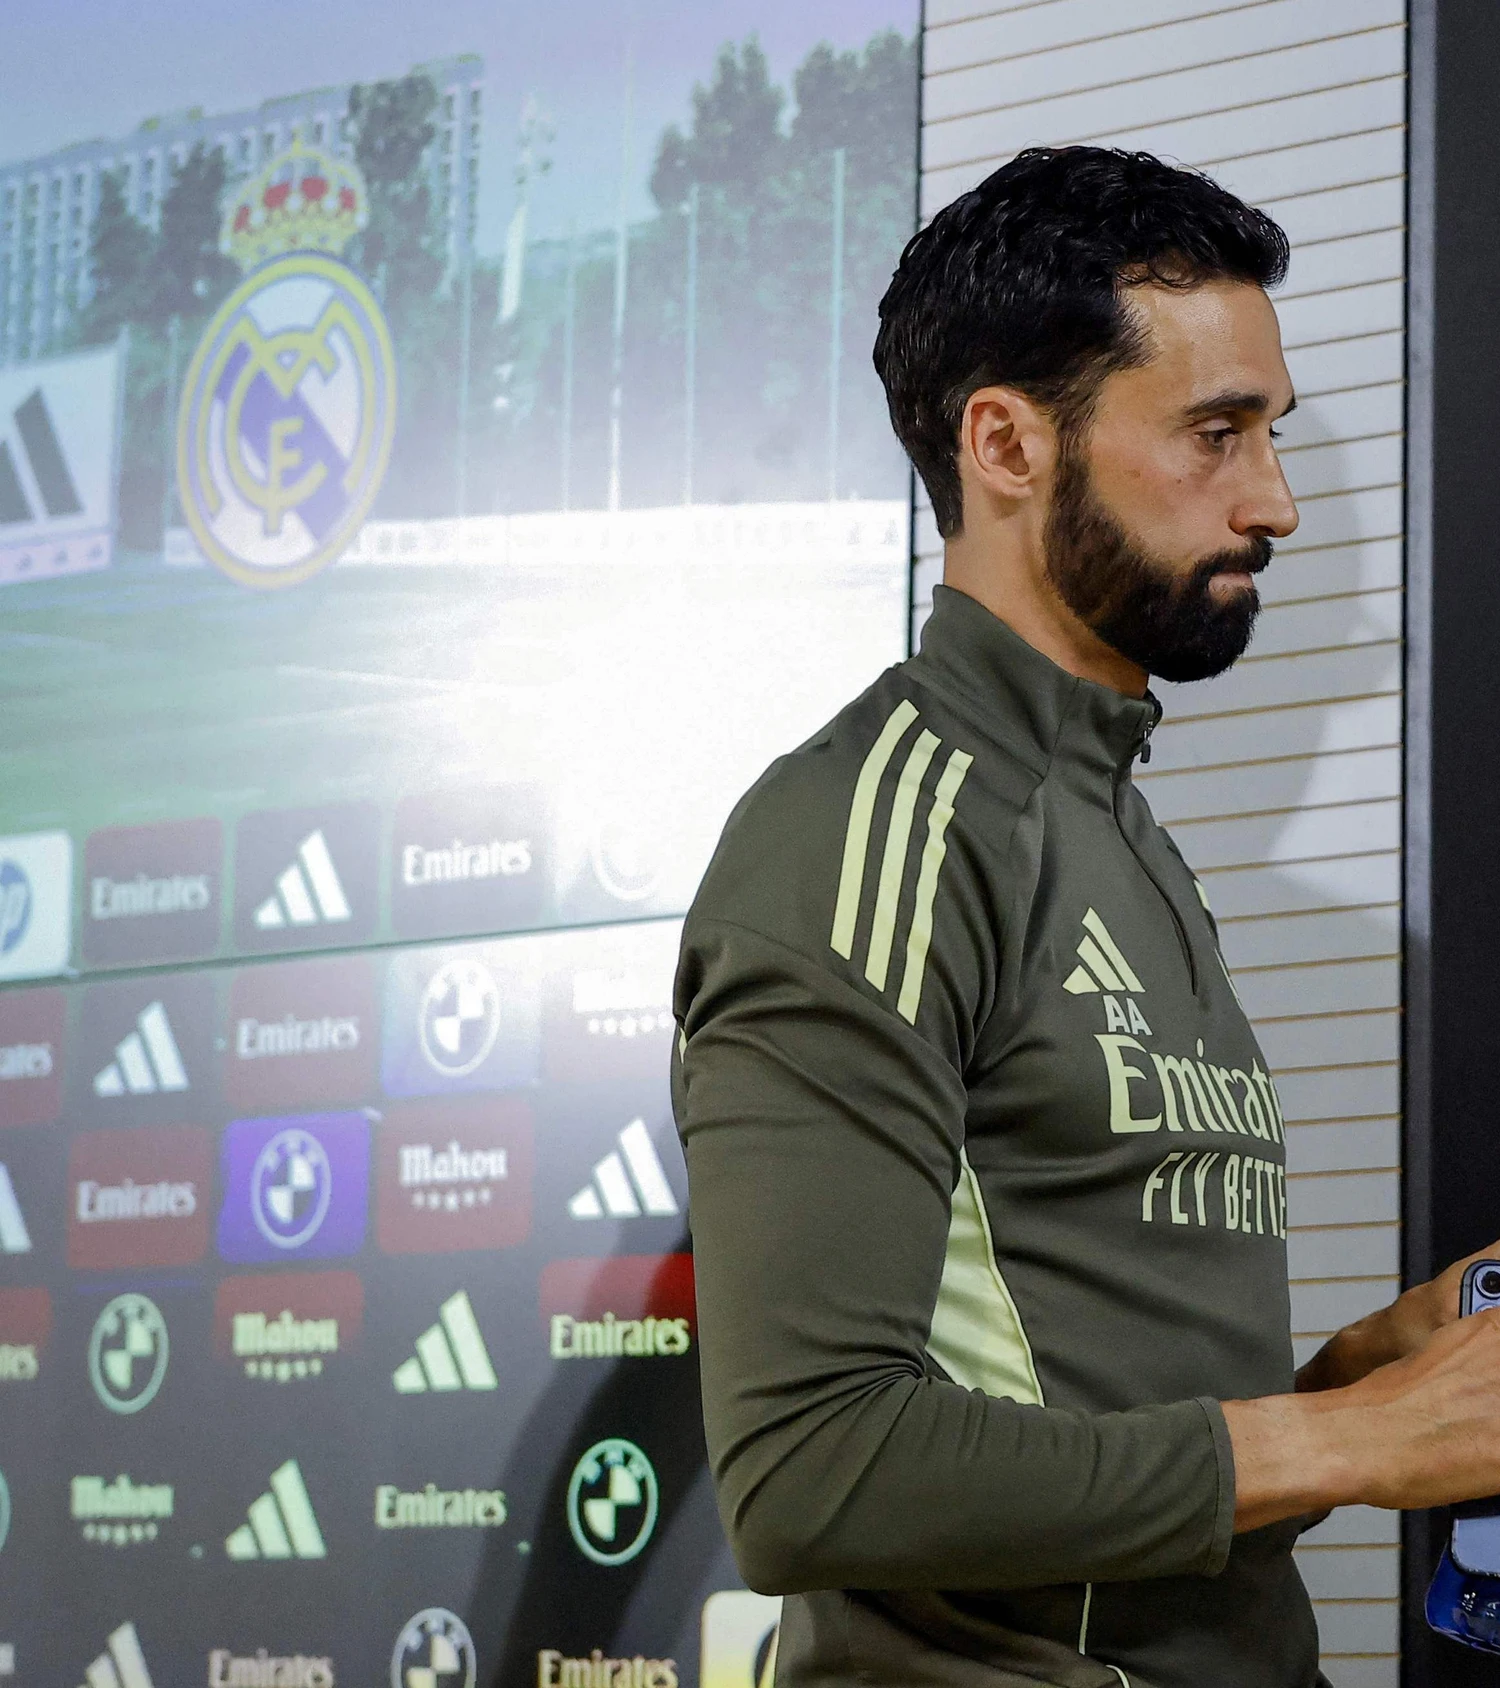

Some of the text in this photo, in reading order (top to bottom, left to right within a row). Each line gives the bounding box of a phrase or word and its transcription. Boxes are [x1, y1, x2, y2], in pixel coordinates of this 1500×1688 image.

[402, 839, 532, 886] Emirates
[1102, 994, 1153, 1036] AA
[1141, 1151, 1220, 1227] FLY
[550, 1311, 690, 1359] Emirates
[375, 1483, 508, 1529] Emirates
